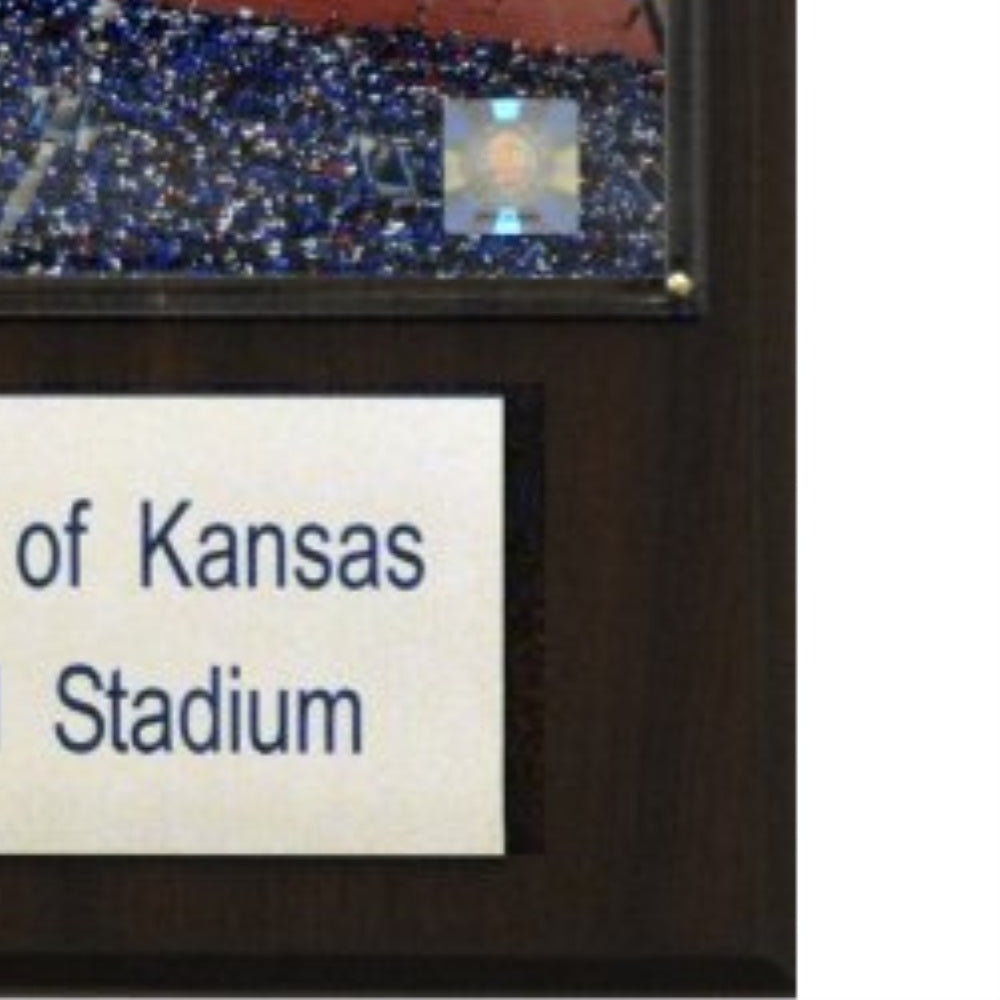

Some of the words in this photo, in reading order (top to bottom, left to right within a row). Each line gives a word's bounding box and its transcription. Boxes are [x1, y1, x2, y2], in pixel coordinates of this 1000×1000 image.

[15, 498, 92, 590] of
[139, 500, 426, 592] Kansas
[53, 662, 363, 756] Stadium
